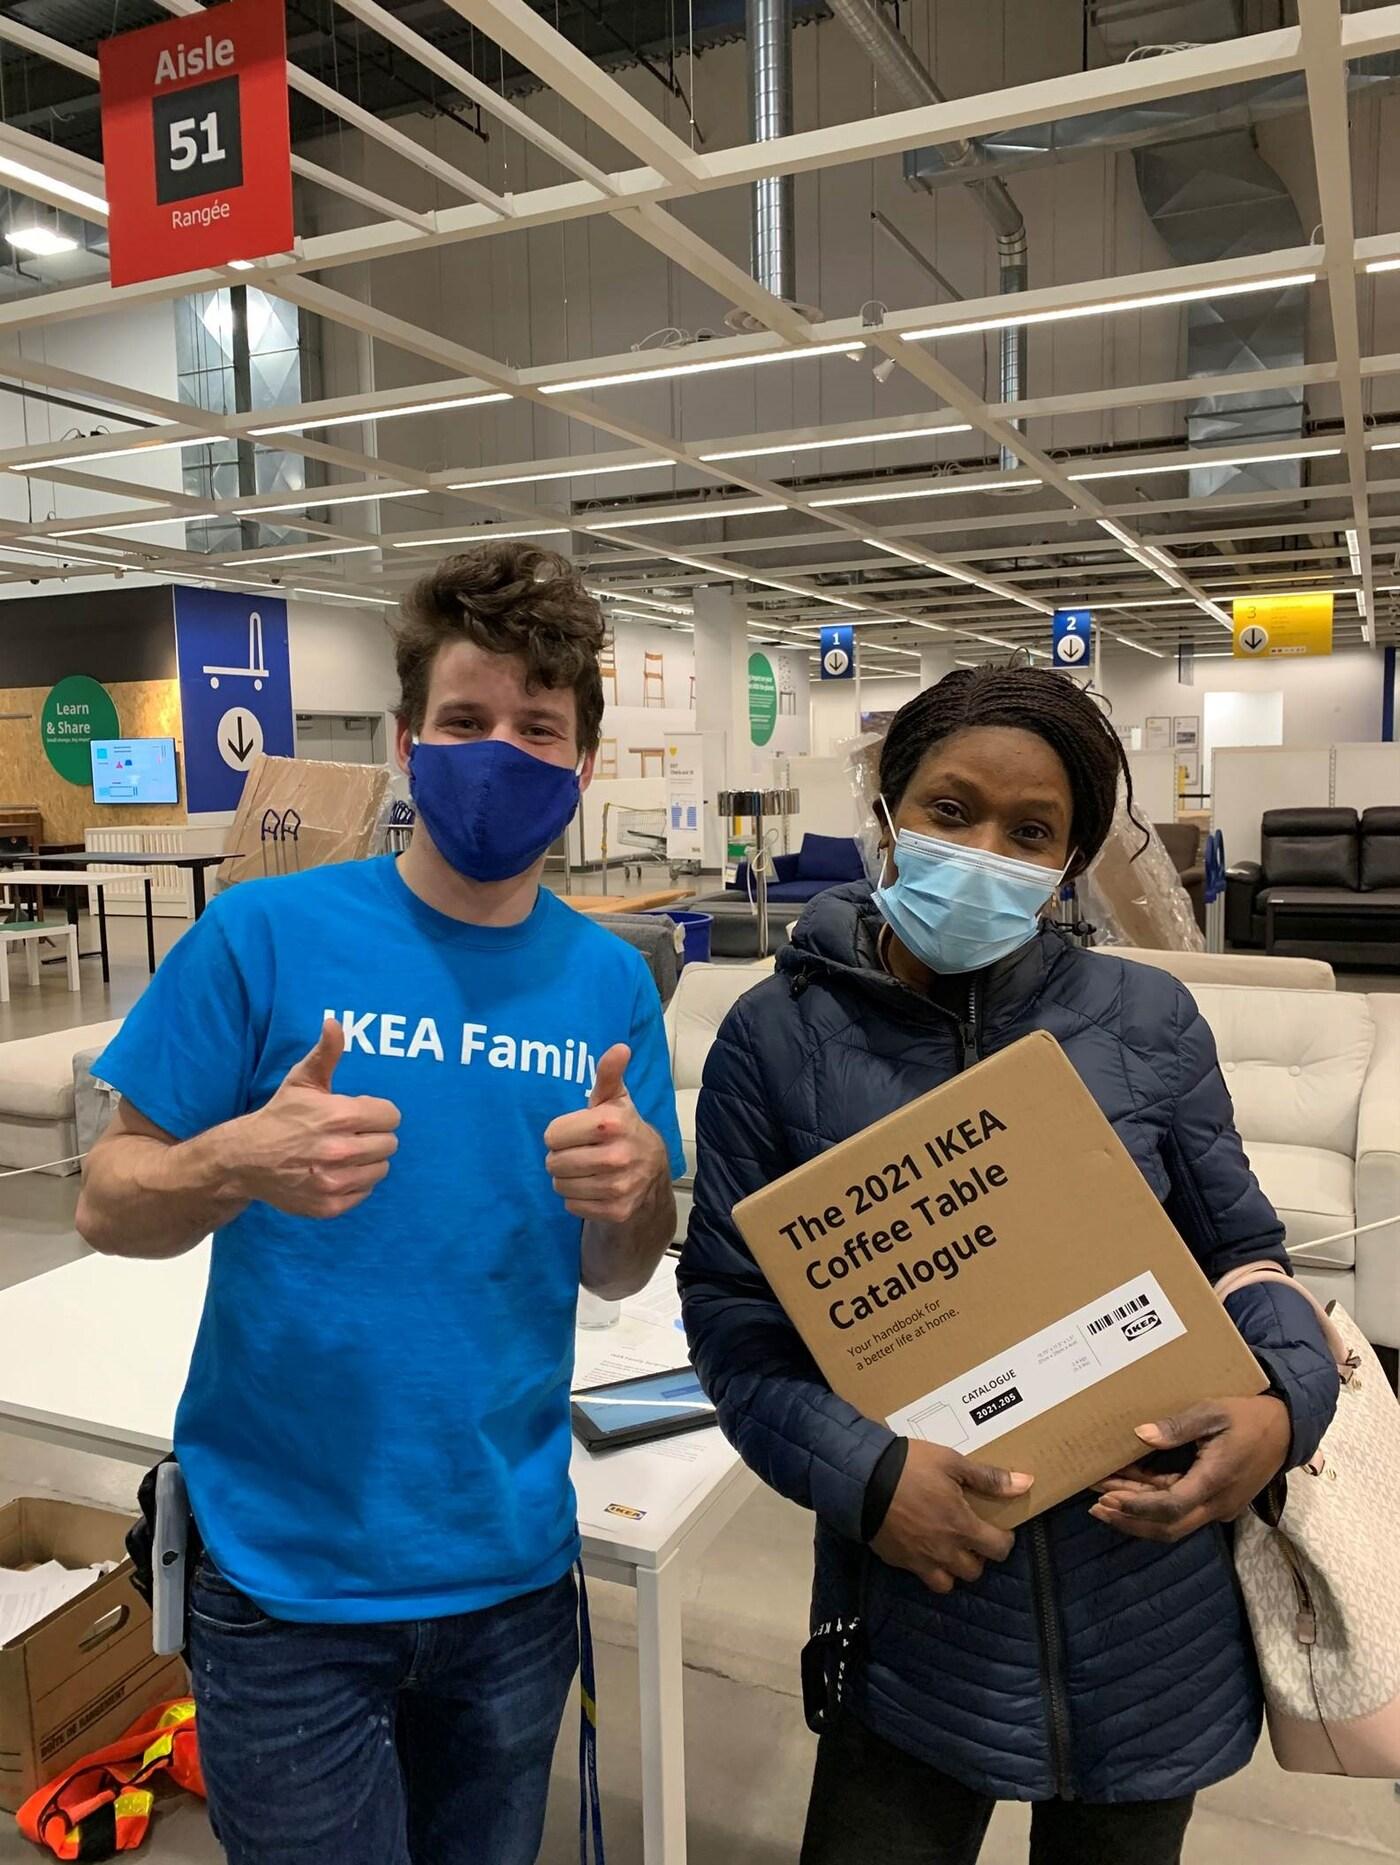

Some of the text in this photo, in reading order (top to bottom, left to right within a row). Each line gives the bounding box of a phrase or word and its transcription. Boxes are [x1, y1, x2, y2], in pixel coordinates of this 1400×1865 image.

[154, 35, 235, 85] Aisle
[169, 111, 226, 171] 51
[172, 199, 231, 229] Rangée
[1066, 616, 1076, 631] 2
[1247, 606, 1257, 619] 3
[832, 633, 840, 645] 1
[56, 702, 90, 715] Learn
[46, 721, 91, 735] & Share
[324, 1009, 597, 1098] KEA Family
[779, 1109, 1007, 1250] The 2021 IKEA
[806, 1162, 1008, 1290] Coffee Table
[829, 1223, 997, 1330] Catalogue
[847, 1298, 942, 1358] Your handbook for
[855, 1308, 960, 1372] a better life at home.
[1126, 1315, 1157, 1336] IKEA
[961, 1368, 1017, 1404] CATALOGUE
[976, 1392, 1017, 1419] 2021.205
[610, 1505, 641, 1518] IKEA
